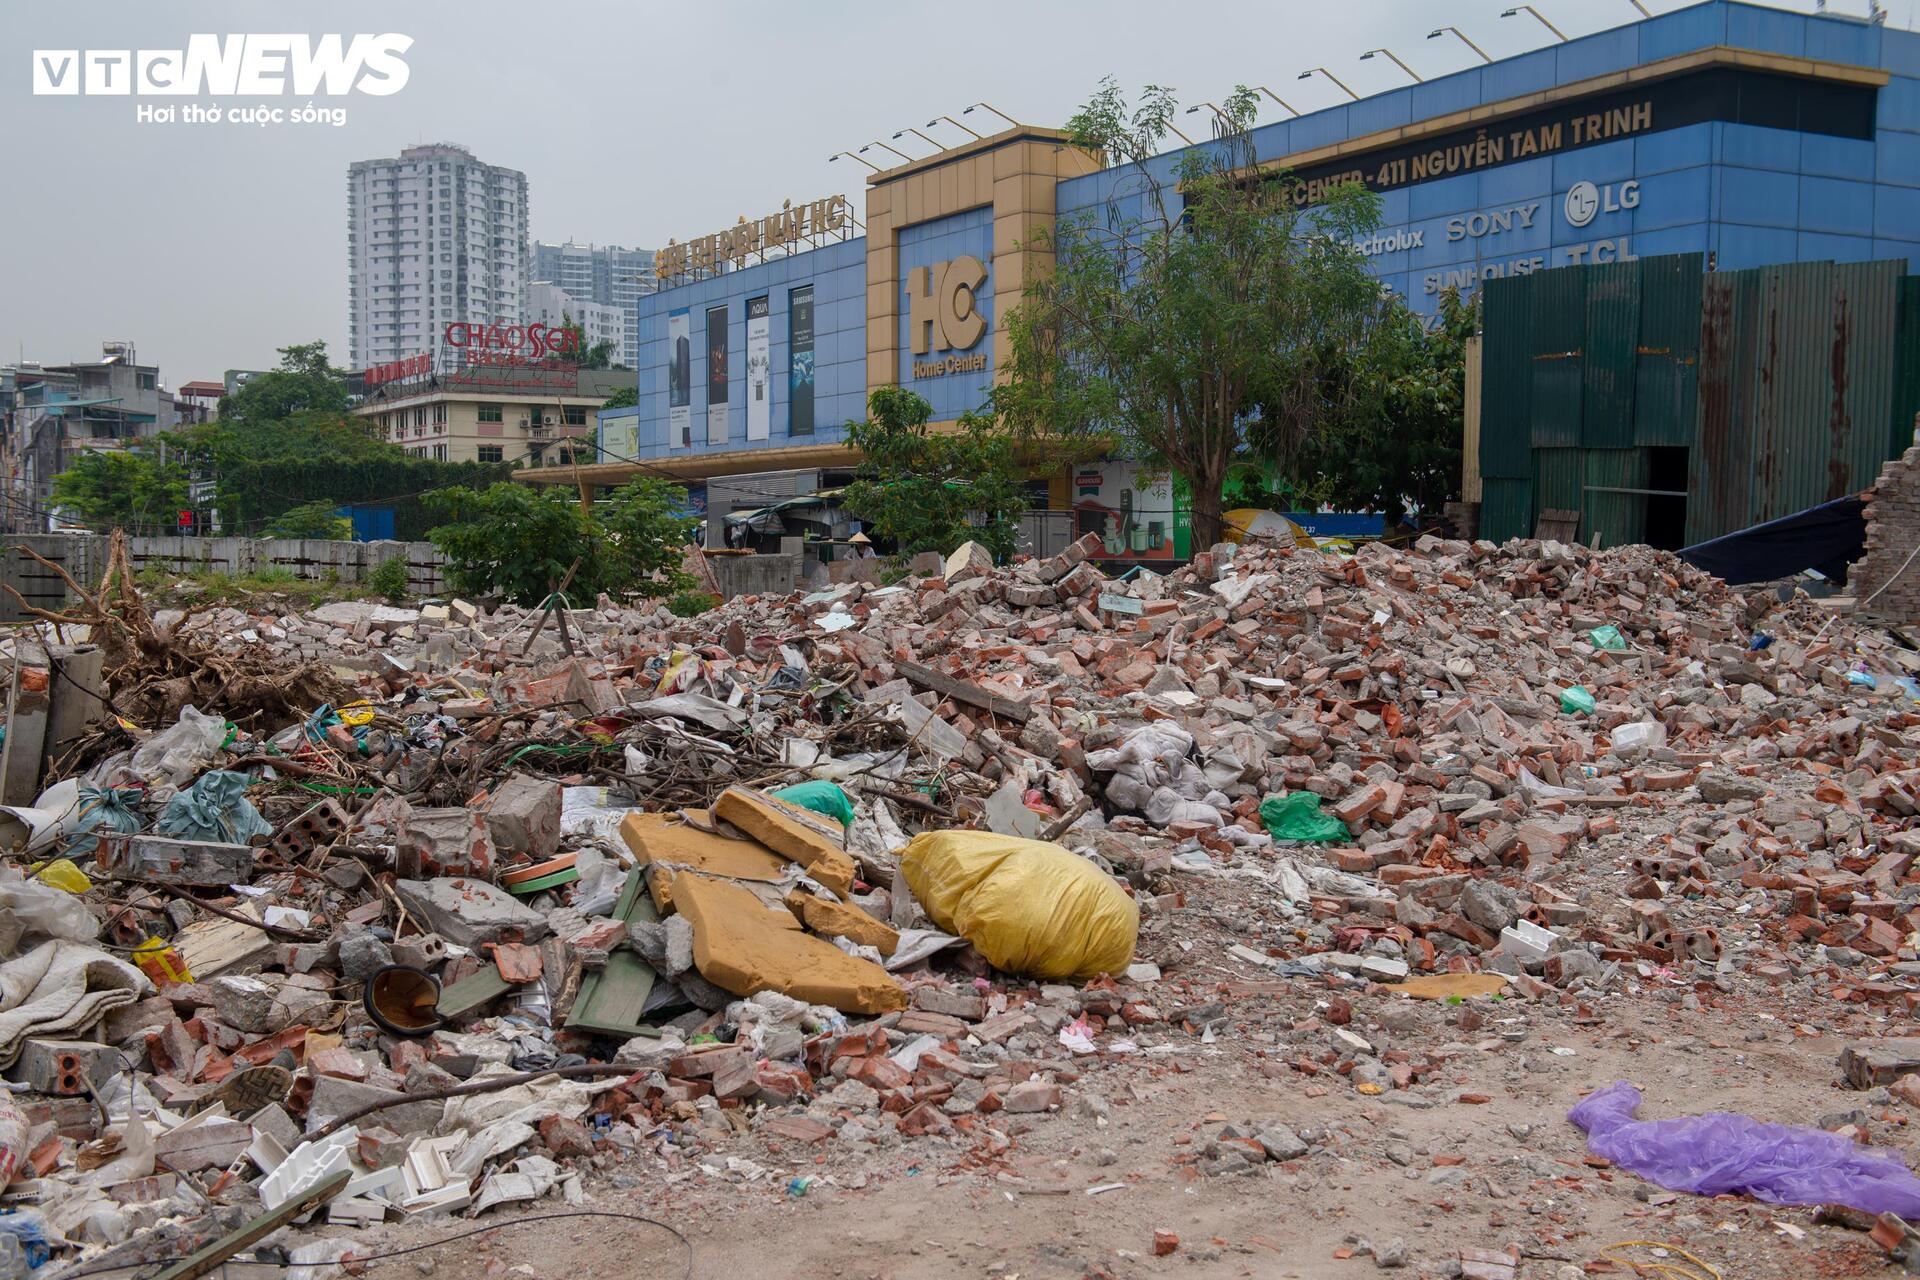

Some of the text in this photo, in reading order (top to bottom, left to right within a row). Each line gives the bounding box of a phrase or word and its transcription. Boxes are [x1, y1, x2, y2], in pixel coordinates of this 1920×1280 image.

[1377, 158, 1406, 187] 411
[1412, 129, 1504, 181] NGUYỄN
[1510, 122, 1562, 158] TAM
[1571, 101, 1652, 144] TRINH
[811, 194, 844, 235] HC
[1604, 180, 1640, 213] LG
[1447, 204, 1540, 242] SONY
[1567, 238, 1639, 266] TCL
[1424, 257, 1544, 295] SUNHOUSE
[752, 303, 768, 315] AQUA
[904, 255, 988, 355] HC
[912, 353, 988, 380] Home Center
